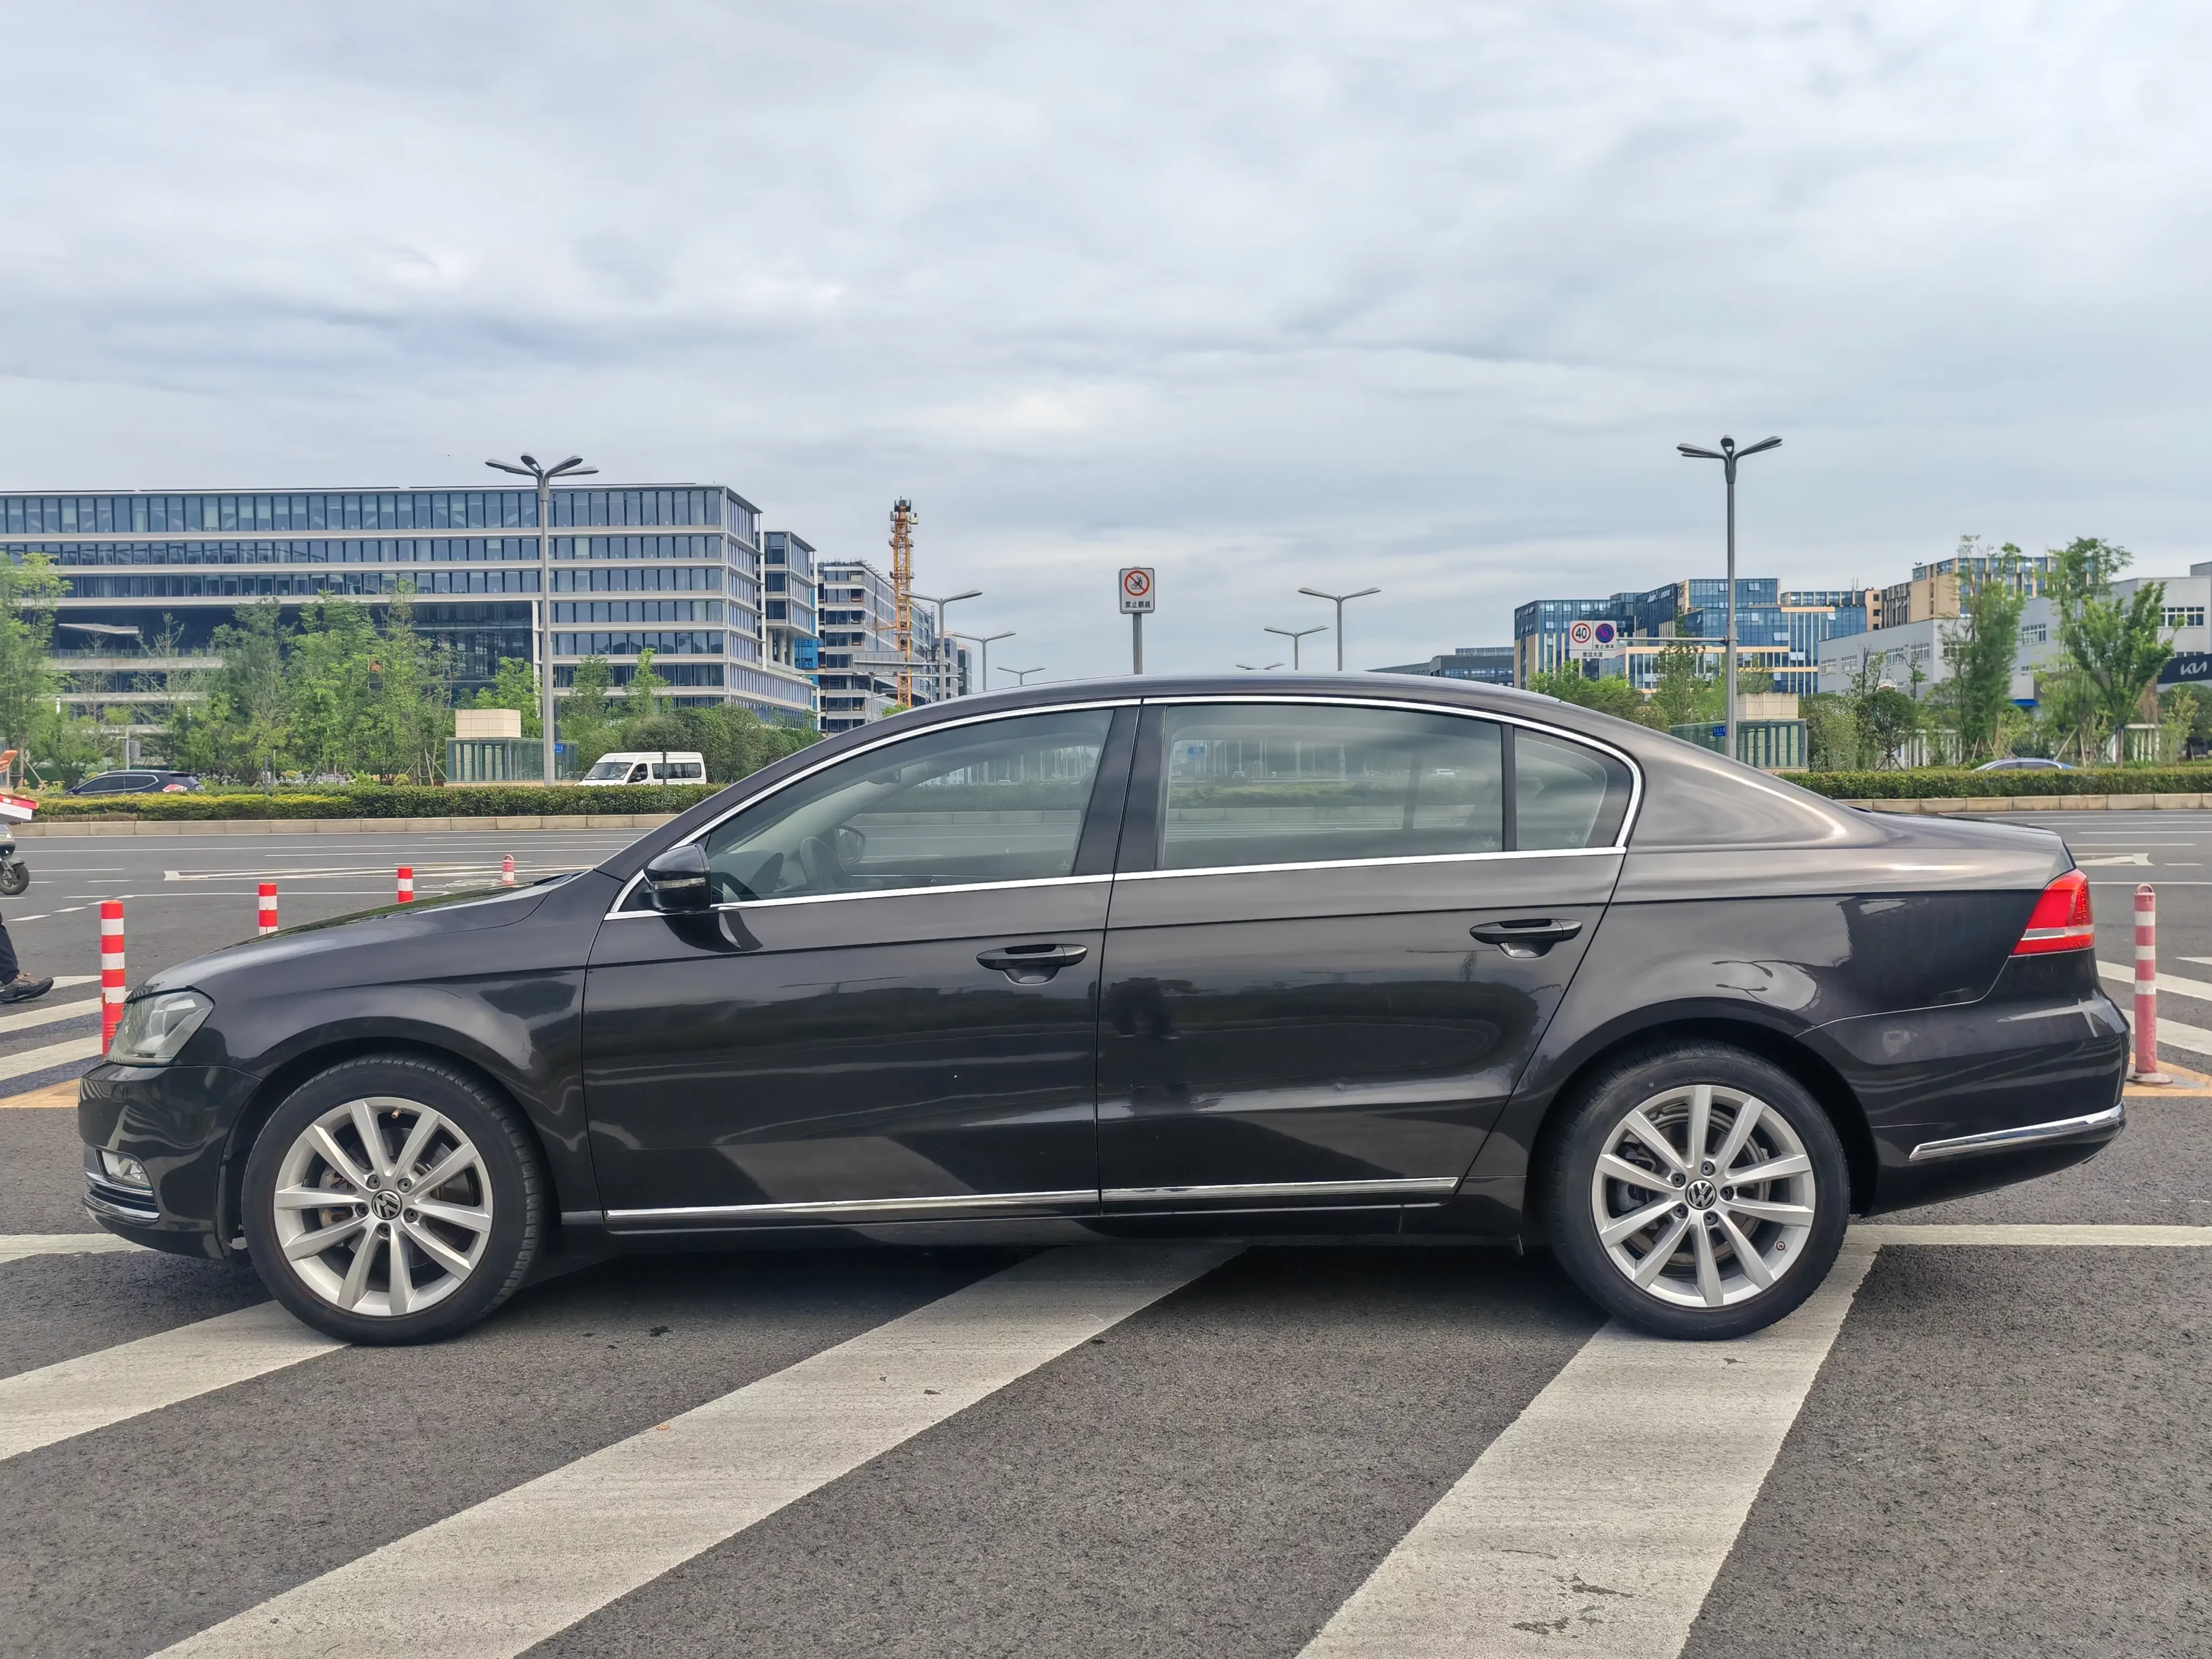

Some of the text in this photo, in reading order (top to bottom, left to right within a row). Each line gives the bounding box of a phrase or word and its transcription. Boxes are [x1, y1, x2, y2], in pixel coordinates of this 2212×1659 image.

[1575, 627, 1587, 639] 40
[2180, 661, 2207, 675] KIA
[373, 1190, 401, 1219] VW
[1687, 1180, 1716, 1209] VW
